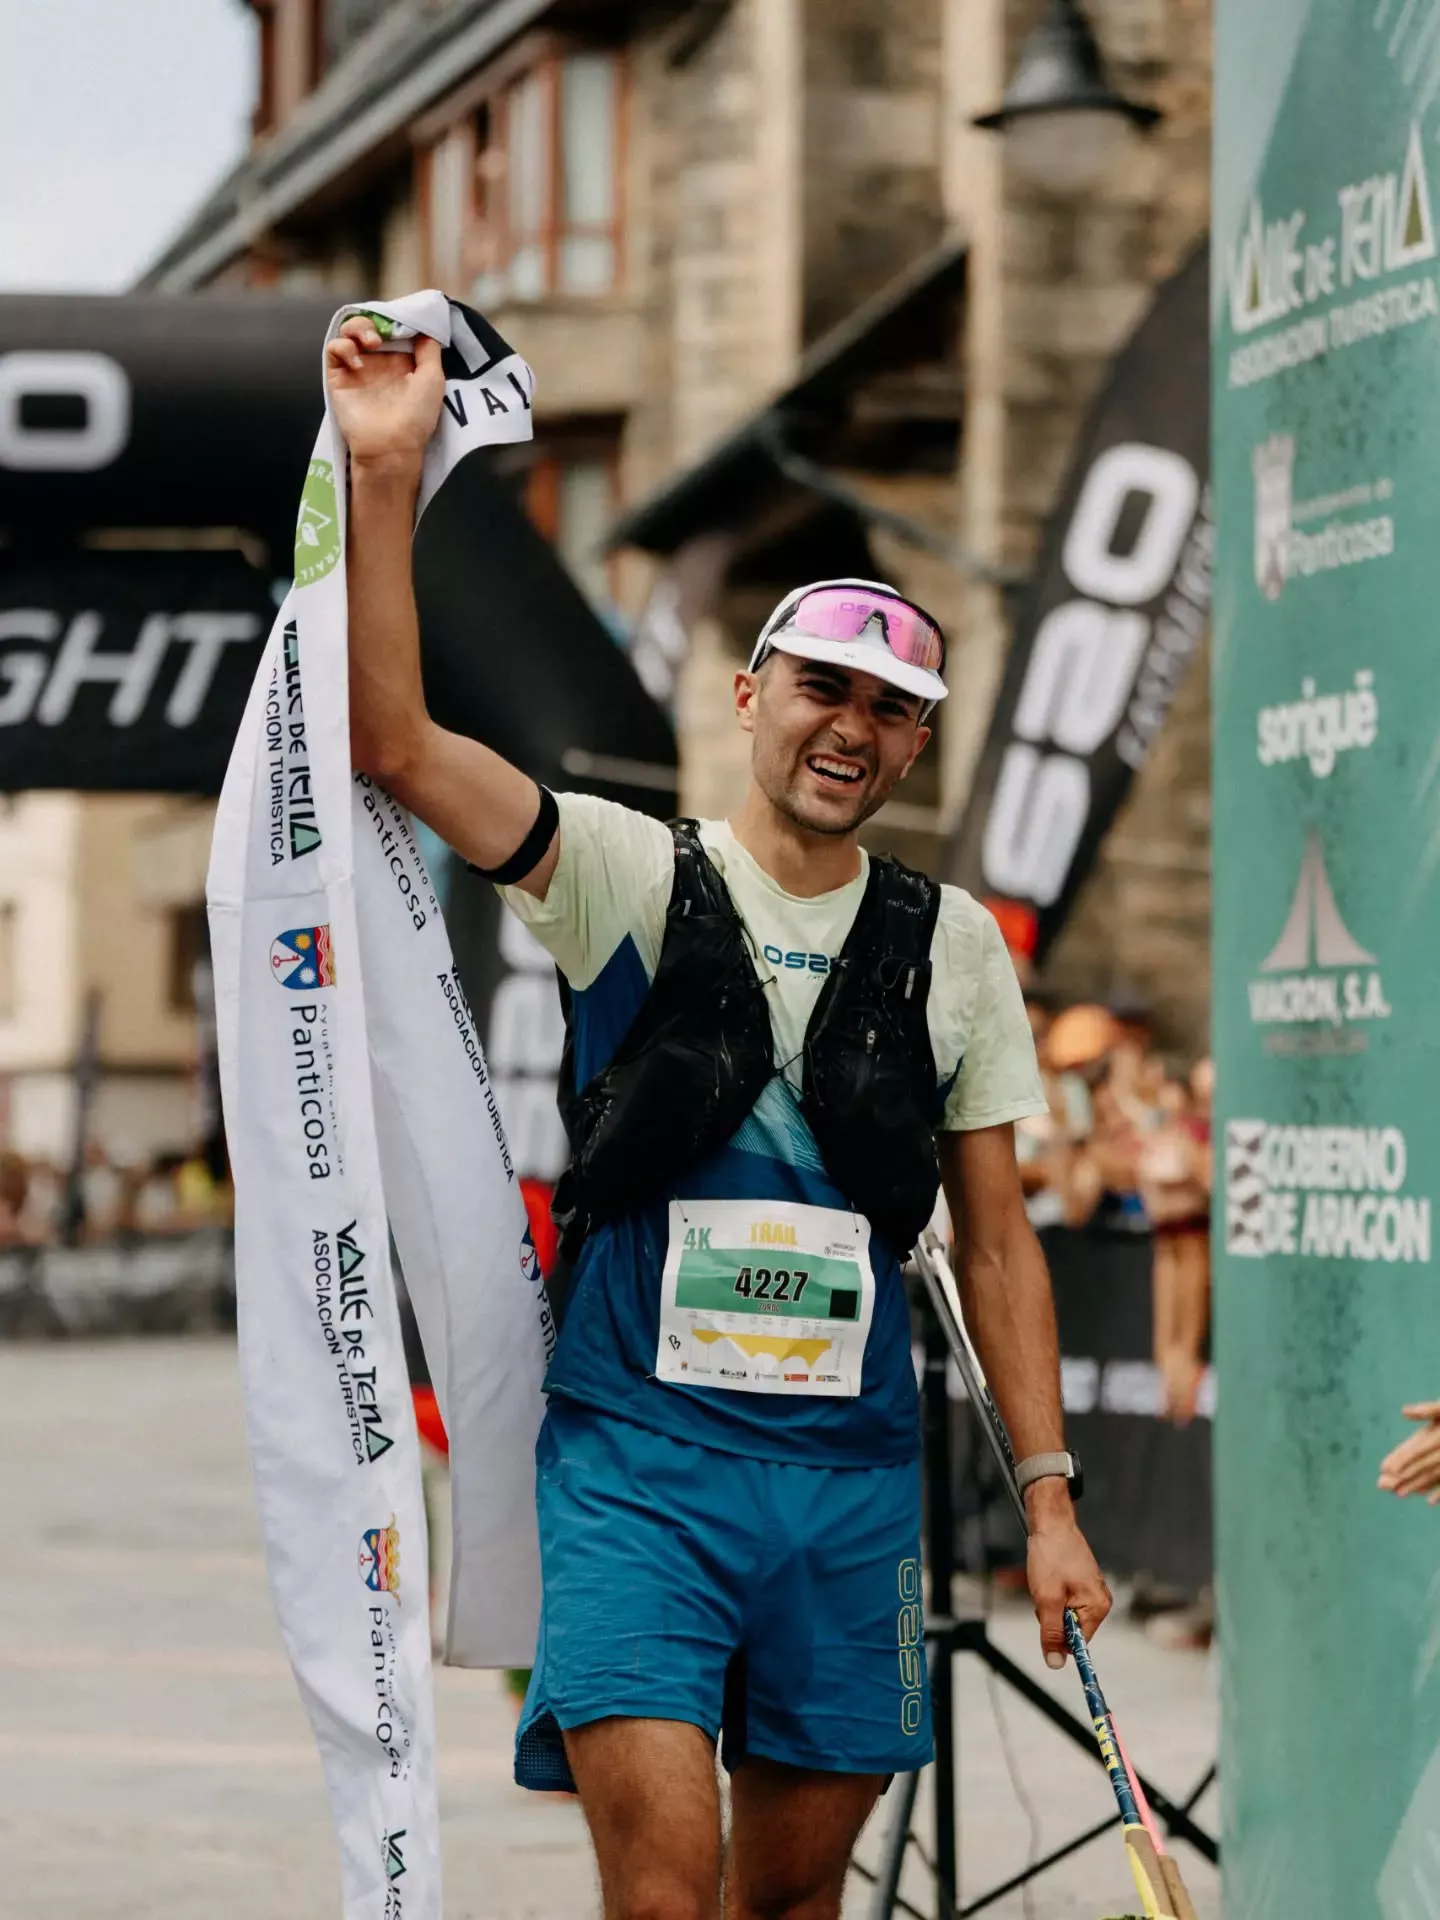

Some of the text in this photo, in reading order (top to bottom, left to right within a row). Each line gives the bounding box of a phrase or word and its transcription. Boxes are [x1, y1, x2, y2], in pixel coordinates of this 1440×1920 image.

[269, 757, 284, 866] TURISTICA
[355, 771, 427, 932] Panticosa
[290, 1004, 330, 1180] Panticosa
[437, 973, 487, 1085] ASOCIACION
[483, 1087, 515, 1183] TURISTICA
[734, 1266, 809, 1303] 4227
[750, 1222, 797, 1246] TRAIL
[312, 1229, 365, 1465] ASOCIACION TURISTICA
